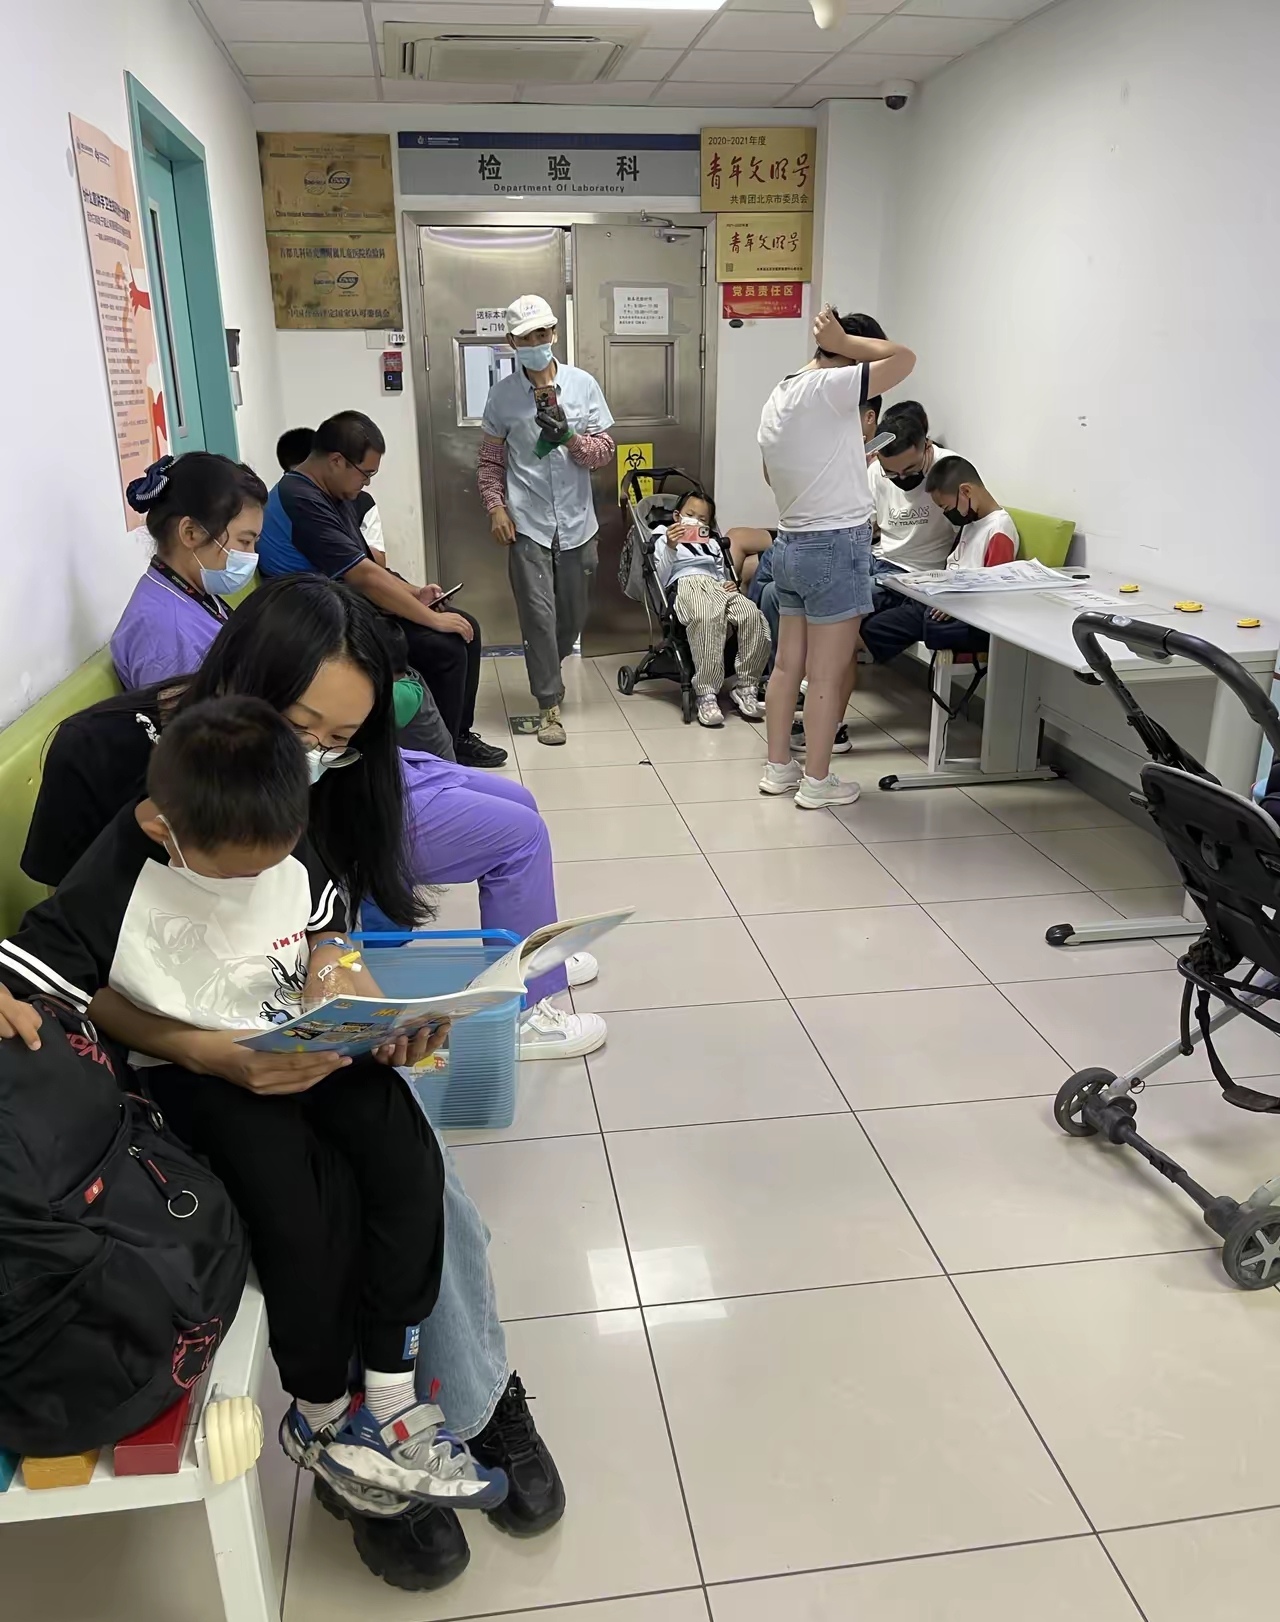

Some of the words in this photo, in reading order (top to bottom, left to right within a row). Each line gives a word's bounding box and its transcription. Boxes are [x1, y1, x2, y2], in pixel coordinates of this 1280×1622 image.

[708, 136, 766, 146] 2020-2021年度
[478, 154, 640, 181] 检验科
[707, 152, 810, 189] 青年文明号
[493, 183, 551, 192] Department
[556, 183, 567, 192] Of
[572, 184, 625, 193] Laboratory
[730, 193, 809, 204] 共青团北京市委员会
[729, 232, 799, 253] 青年文明号
[732, 285, 793, 296] 党员责任区
[489, 323, 505, 331] 门铃
[272, 937, 291, 950] I'M
